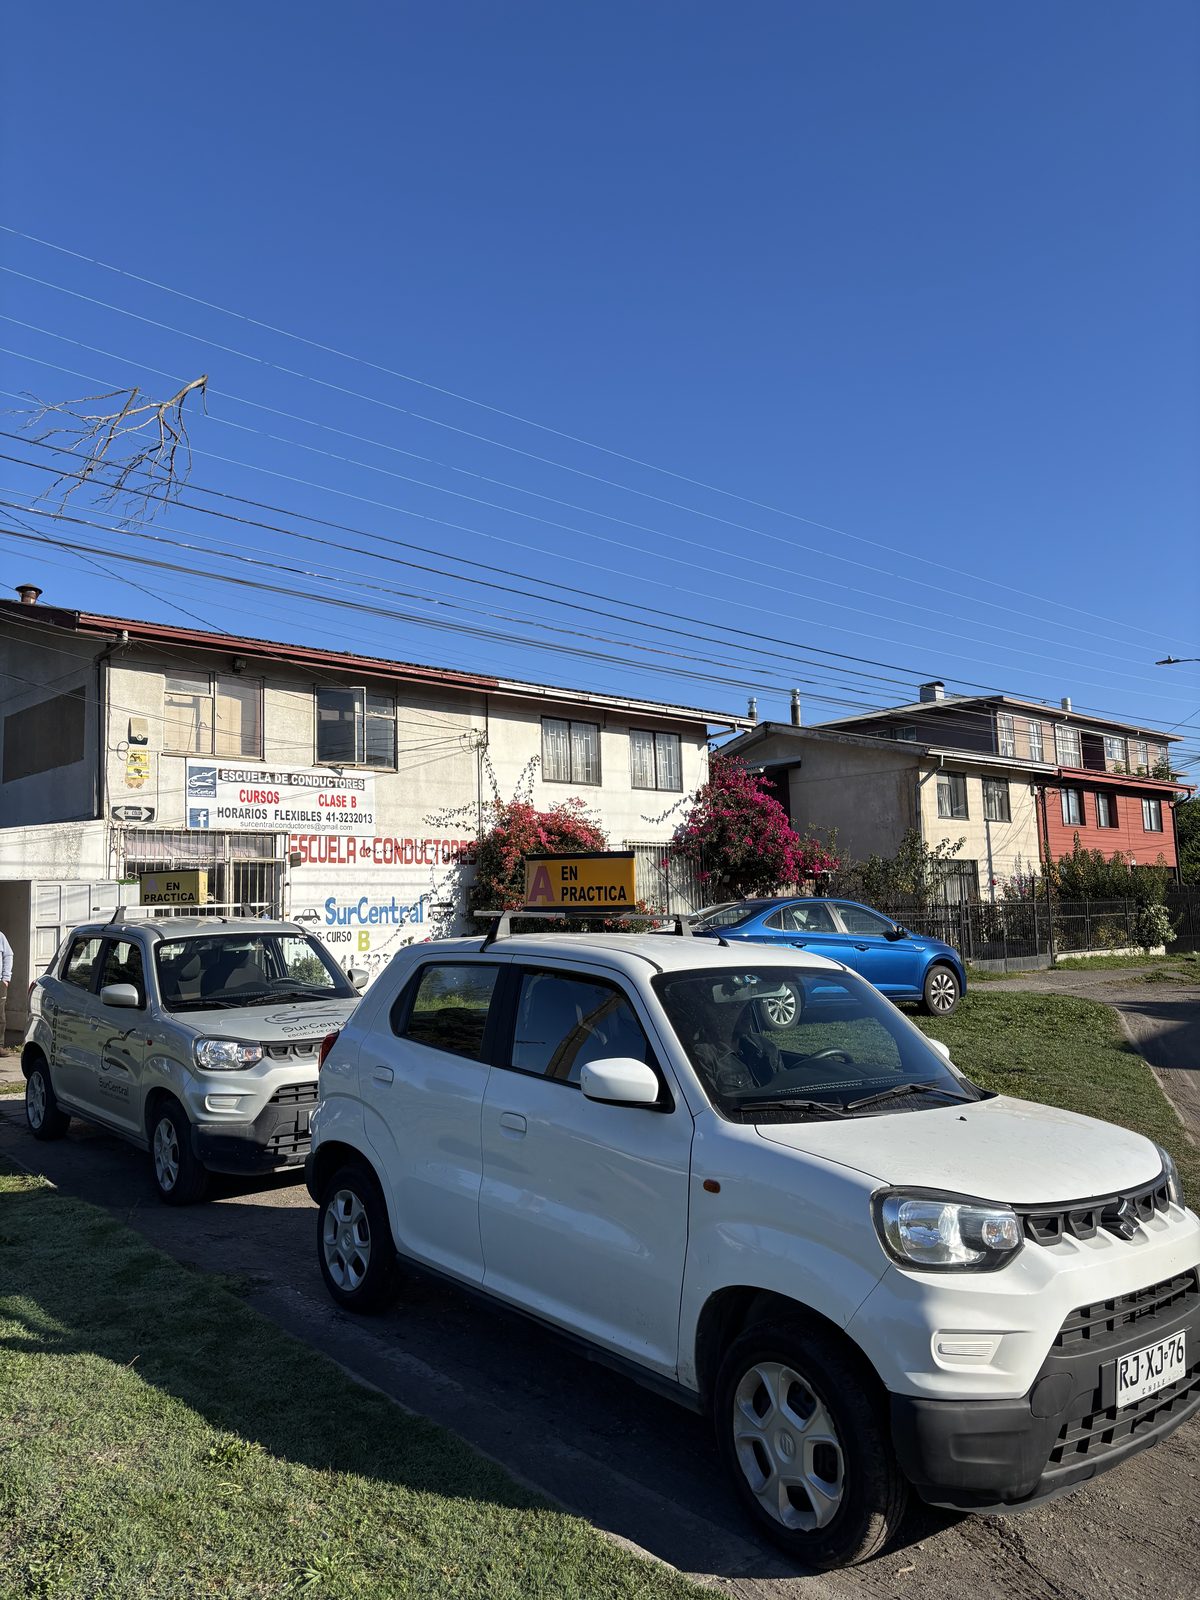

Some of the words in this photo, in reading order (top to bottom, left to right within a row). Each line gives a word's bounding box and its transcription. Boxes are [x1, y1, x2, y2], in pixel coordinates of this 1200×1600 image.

[222, 770, 272, 784] ESCUELA
[274, 773, 288, 785] DE
[291, 774, 365, 790] CONDUCTORES
[239, 789, 280, 804] CURSOS
[318, 793, 347, 808] CLASE
[350, 796, 357, 808] B
[217, 807, 268, 820] HORARIOS
[274, 809, 322, 822] FLEXIBLES
[326, 811, 373, 824] 41-3232013
[288, 834, 356, 864] ESCUELA
[359, 839, 371, 858] de
[372, 837, 478, 866] CONDUCTORES
[561, 865, 578, 881] EN
[146, 879, 158, 892] A
[166, 882, 180, 891] EN
[529, 866, 555, 902] A
[143, 892, 194, 903] PRACTICA
[561, 885, 627, 902] PRACTICA
[325, 896, 424, 925] SurCentral
[326, 931, 352, 943] CURSO
[357, 930, 370, 951] B
